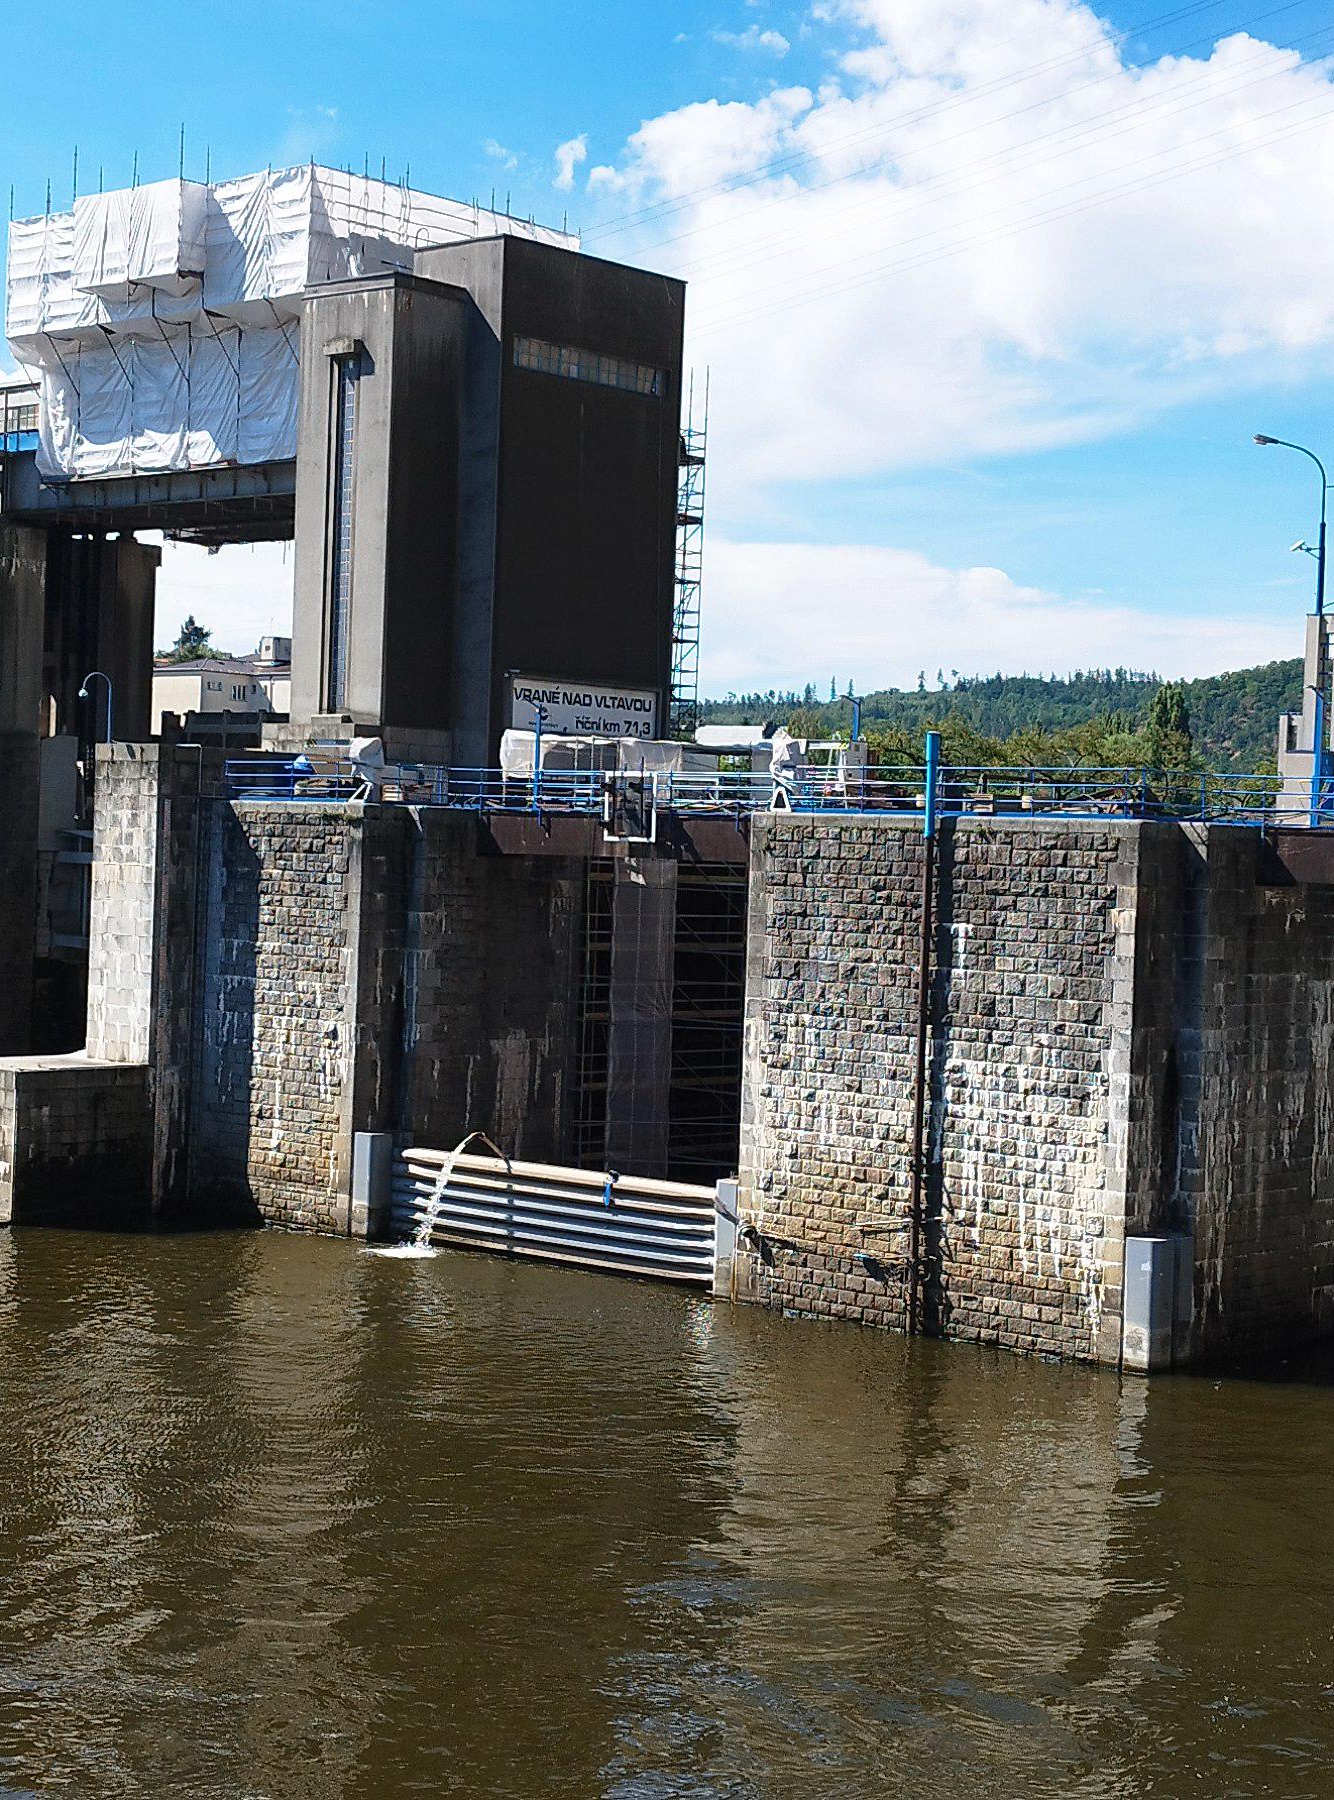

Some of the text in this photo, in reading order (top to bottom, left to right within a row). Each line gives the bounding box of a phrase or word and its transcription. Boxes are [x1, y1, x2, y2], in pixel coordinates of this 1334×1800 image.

[514, 686, 652, 712] VRANÉ NAD VLTAVOU
[575, 715, 602, 731] říční
[603, 720, 621, 732] km
[623, 721, 651, 737] 71,3
